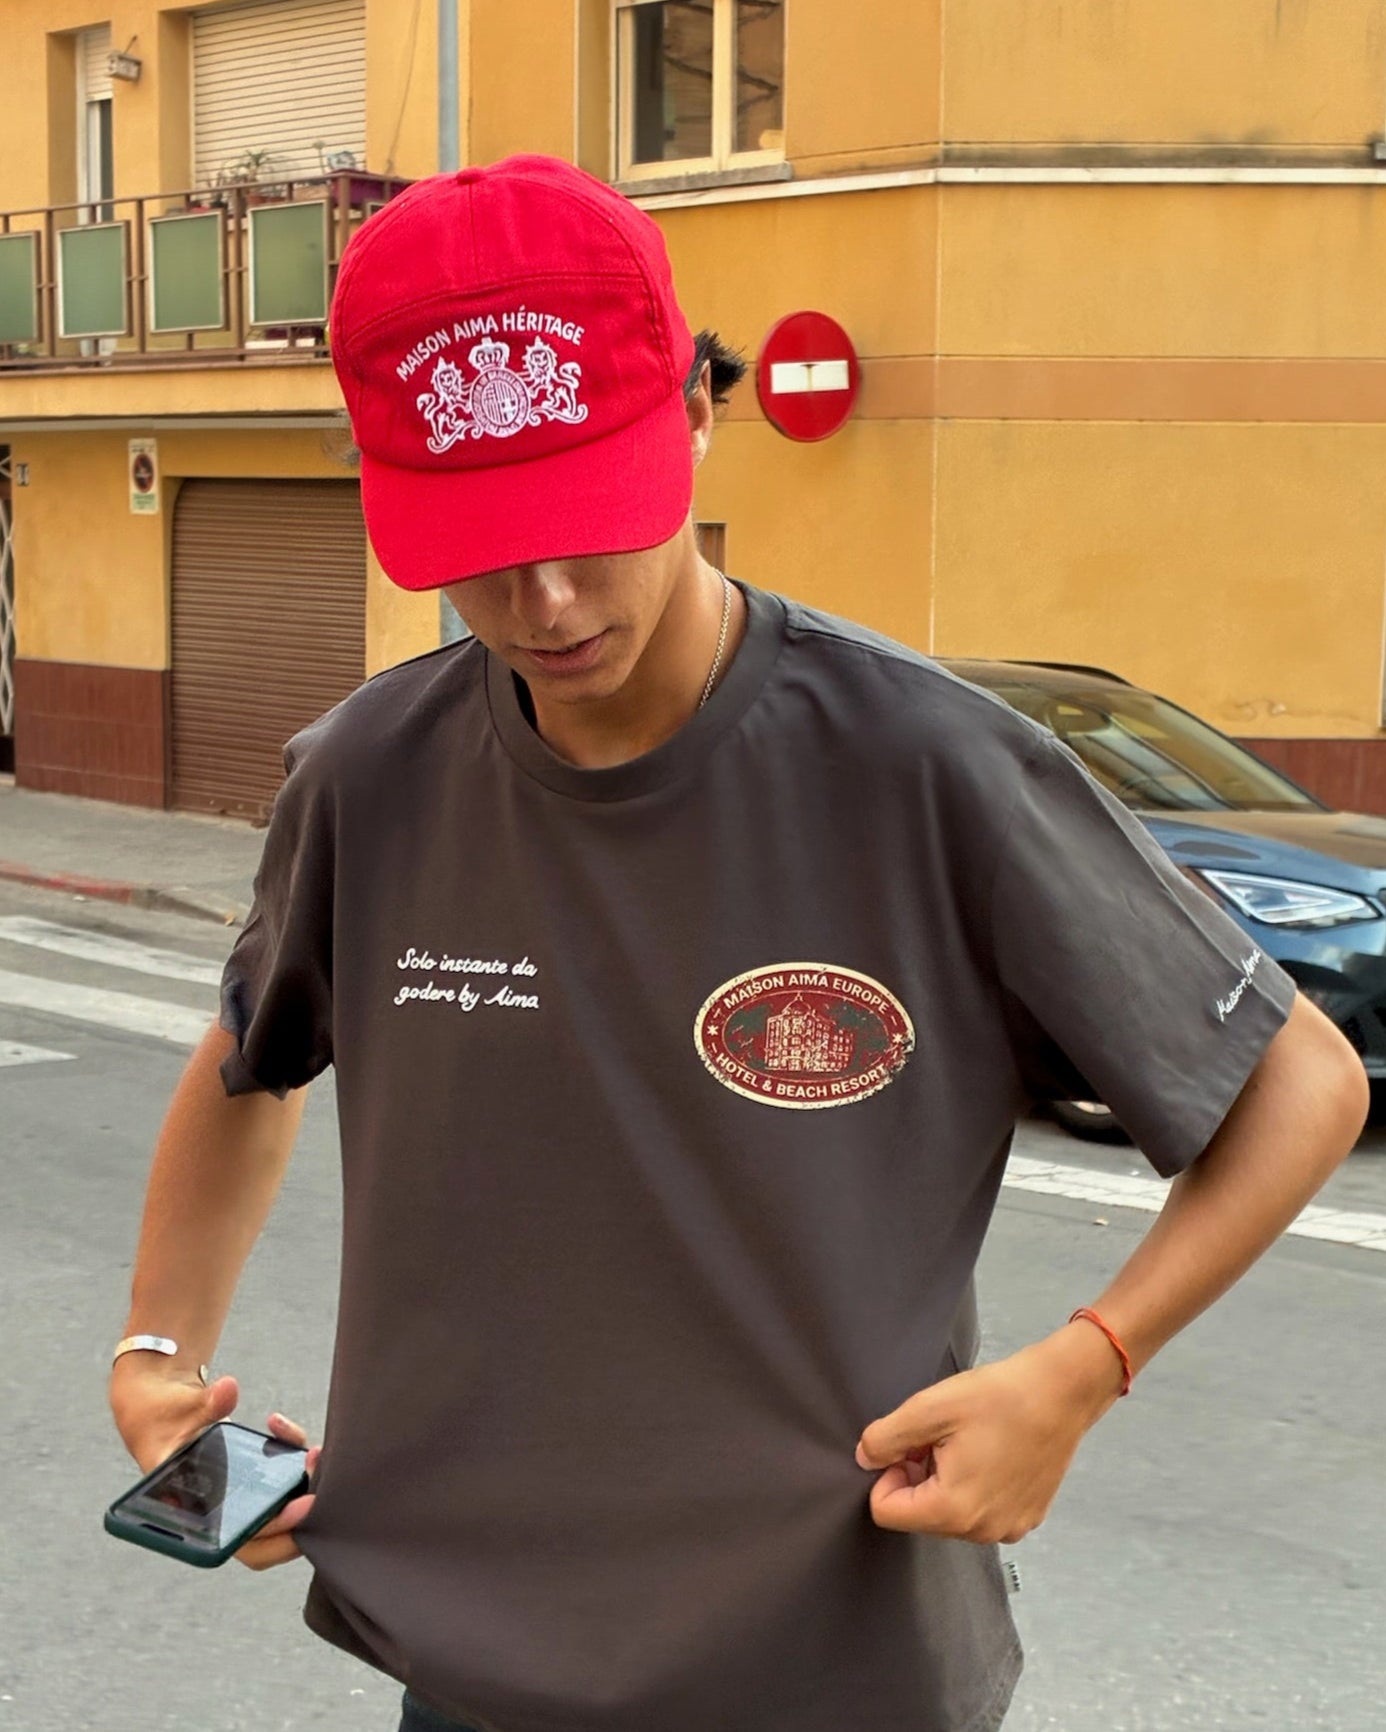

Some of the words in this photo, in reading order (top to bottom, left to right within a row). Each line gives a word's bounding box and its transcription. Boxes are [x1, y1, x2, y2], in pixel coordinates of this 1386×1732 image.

[396, 328, 451, 382] MAISON
[453, 314, 499, 342] AIMA
[502, 305, 585, 346] HÉRITAGE
[397, 948, 437, 969] Solo
[439, 954, 508, 974] instante
[512, 956, 538, 976] da
[394, 981, 456, 1005] godere
[457, 983, 480, 1012] by
[484, 986, 539, 1008] Aima
[723, 975, 784, 1009] MAISON
[788, 973, 828, 987] AIMA
[832, 978, 889, 1014] EUROPE
[715, 1053, 758, 1087] HOTEL
[762, 1080, 772, 1092] &
[776, 1082, 827, 1098] BEACH
[831, 1064, 885, 1094] RESORT
